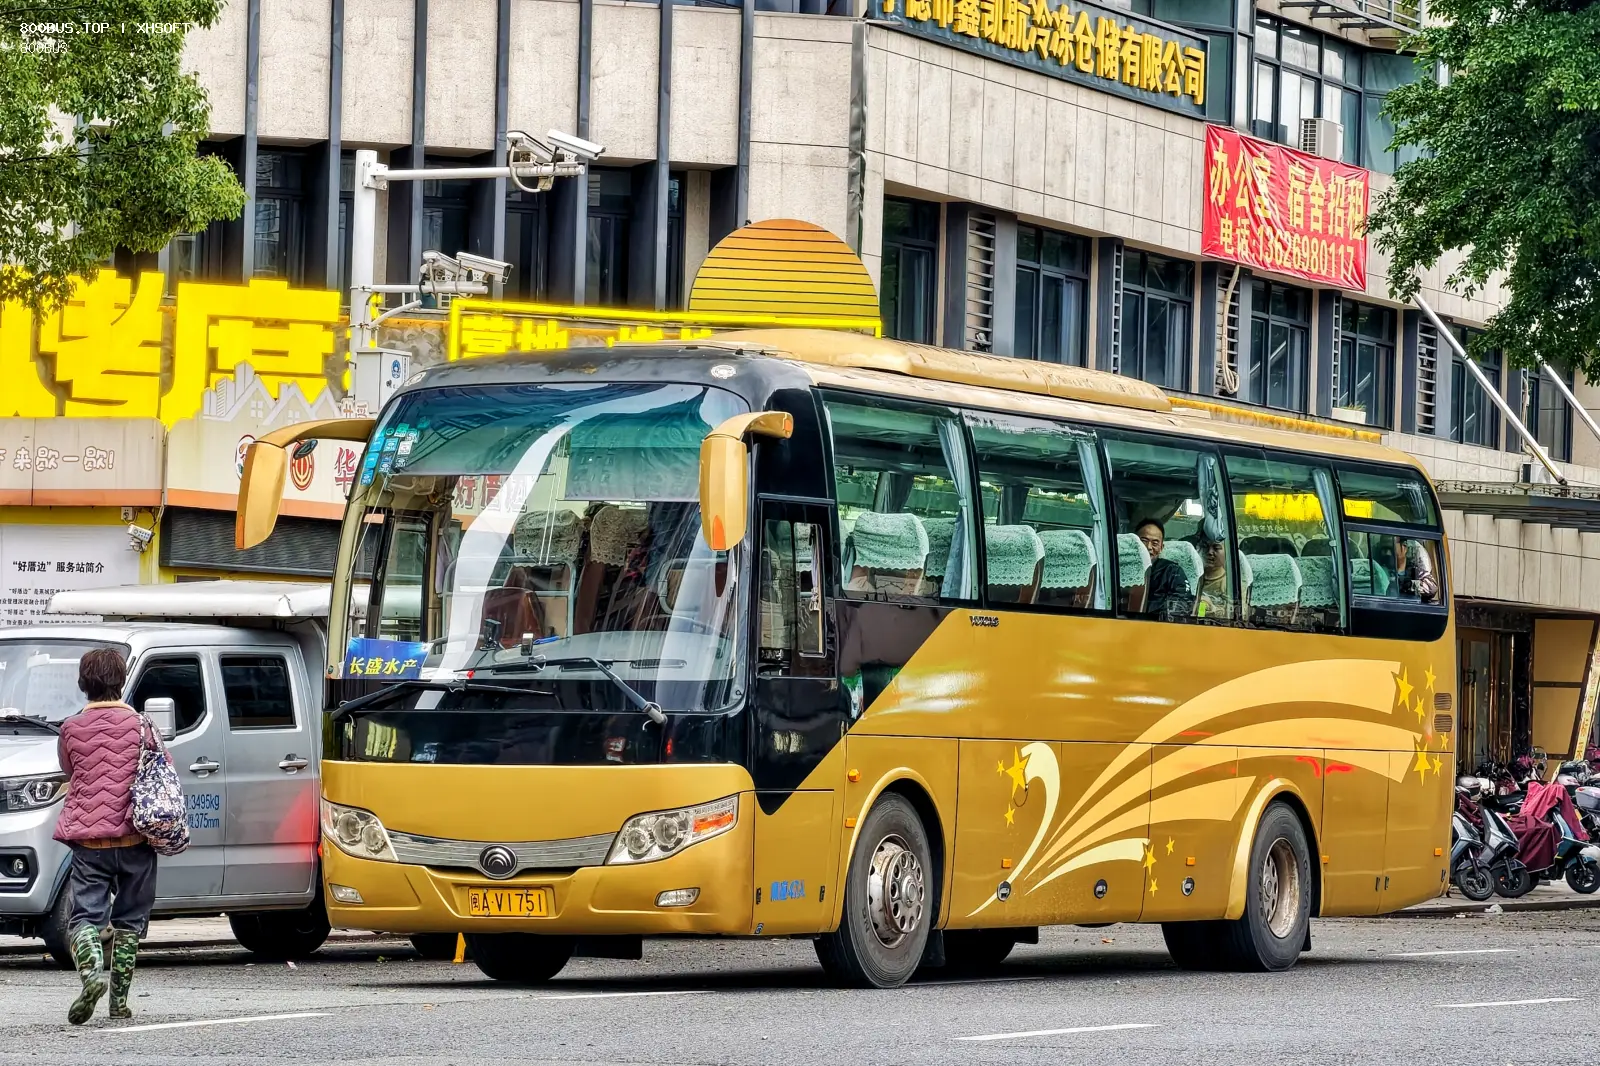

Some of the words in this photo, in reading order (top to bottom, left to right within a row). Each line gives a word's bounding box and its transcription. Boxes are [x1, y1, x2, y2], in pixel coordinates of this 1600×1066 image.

[883, 0, 1206, 105] 鑫凯航冷冻仓储有限公司
[1288, 160, 1367, 241] 宿舍招租
[350, 657, 418, 675] 长盛水产
